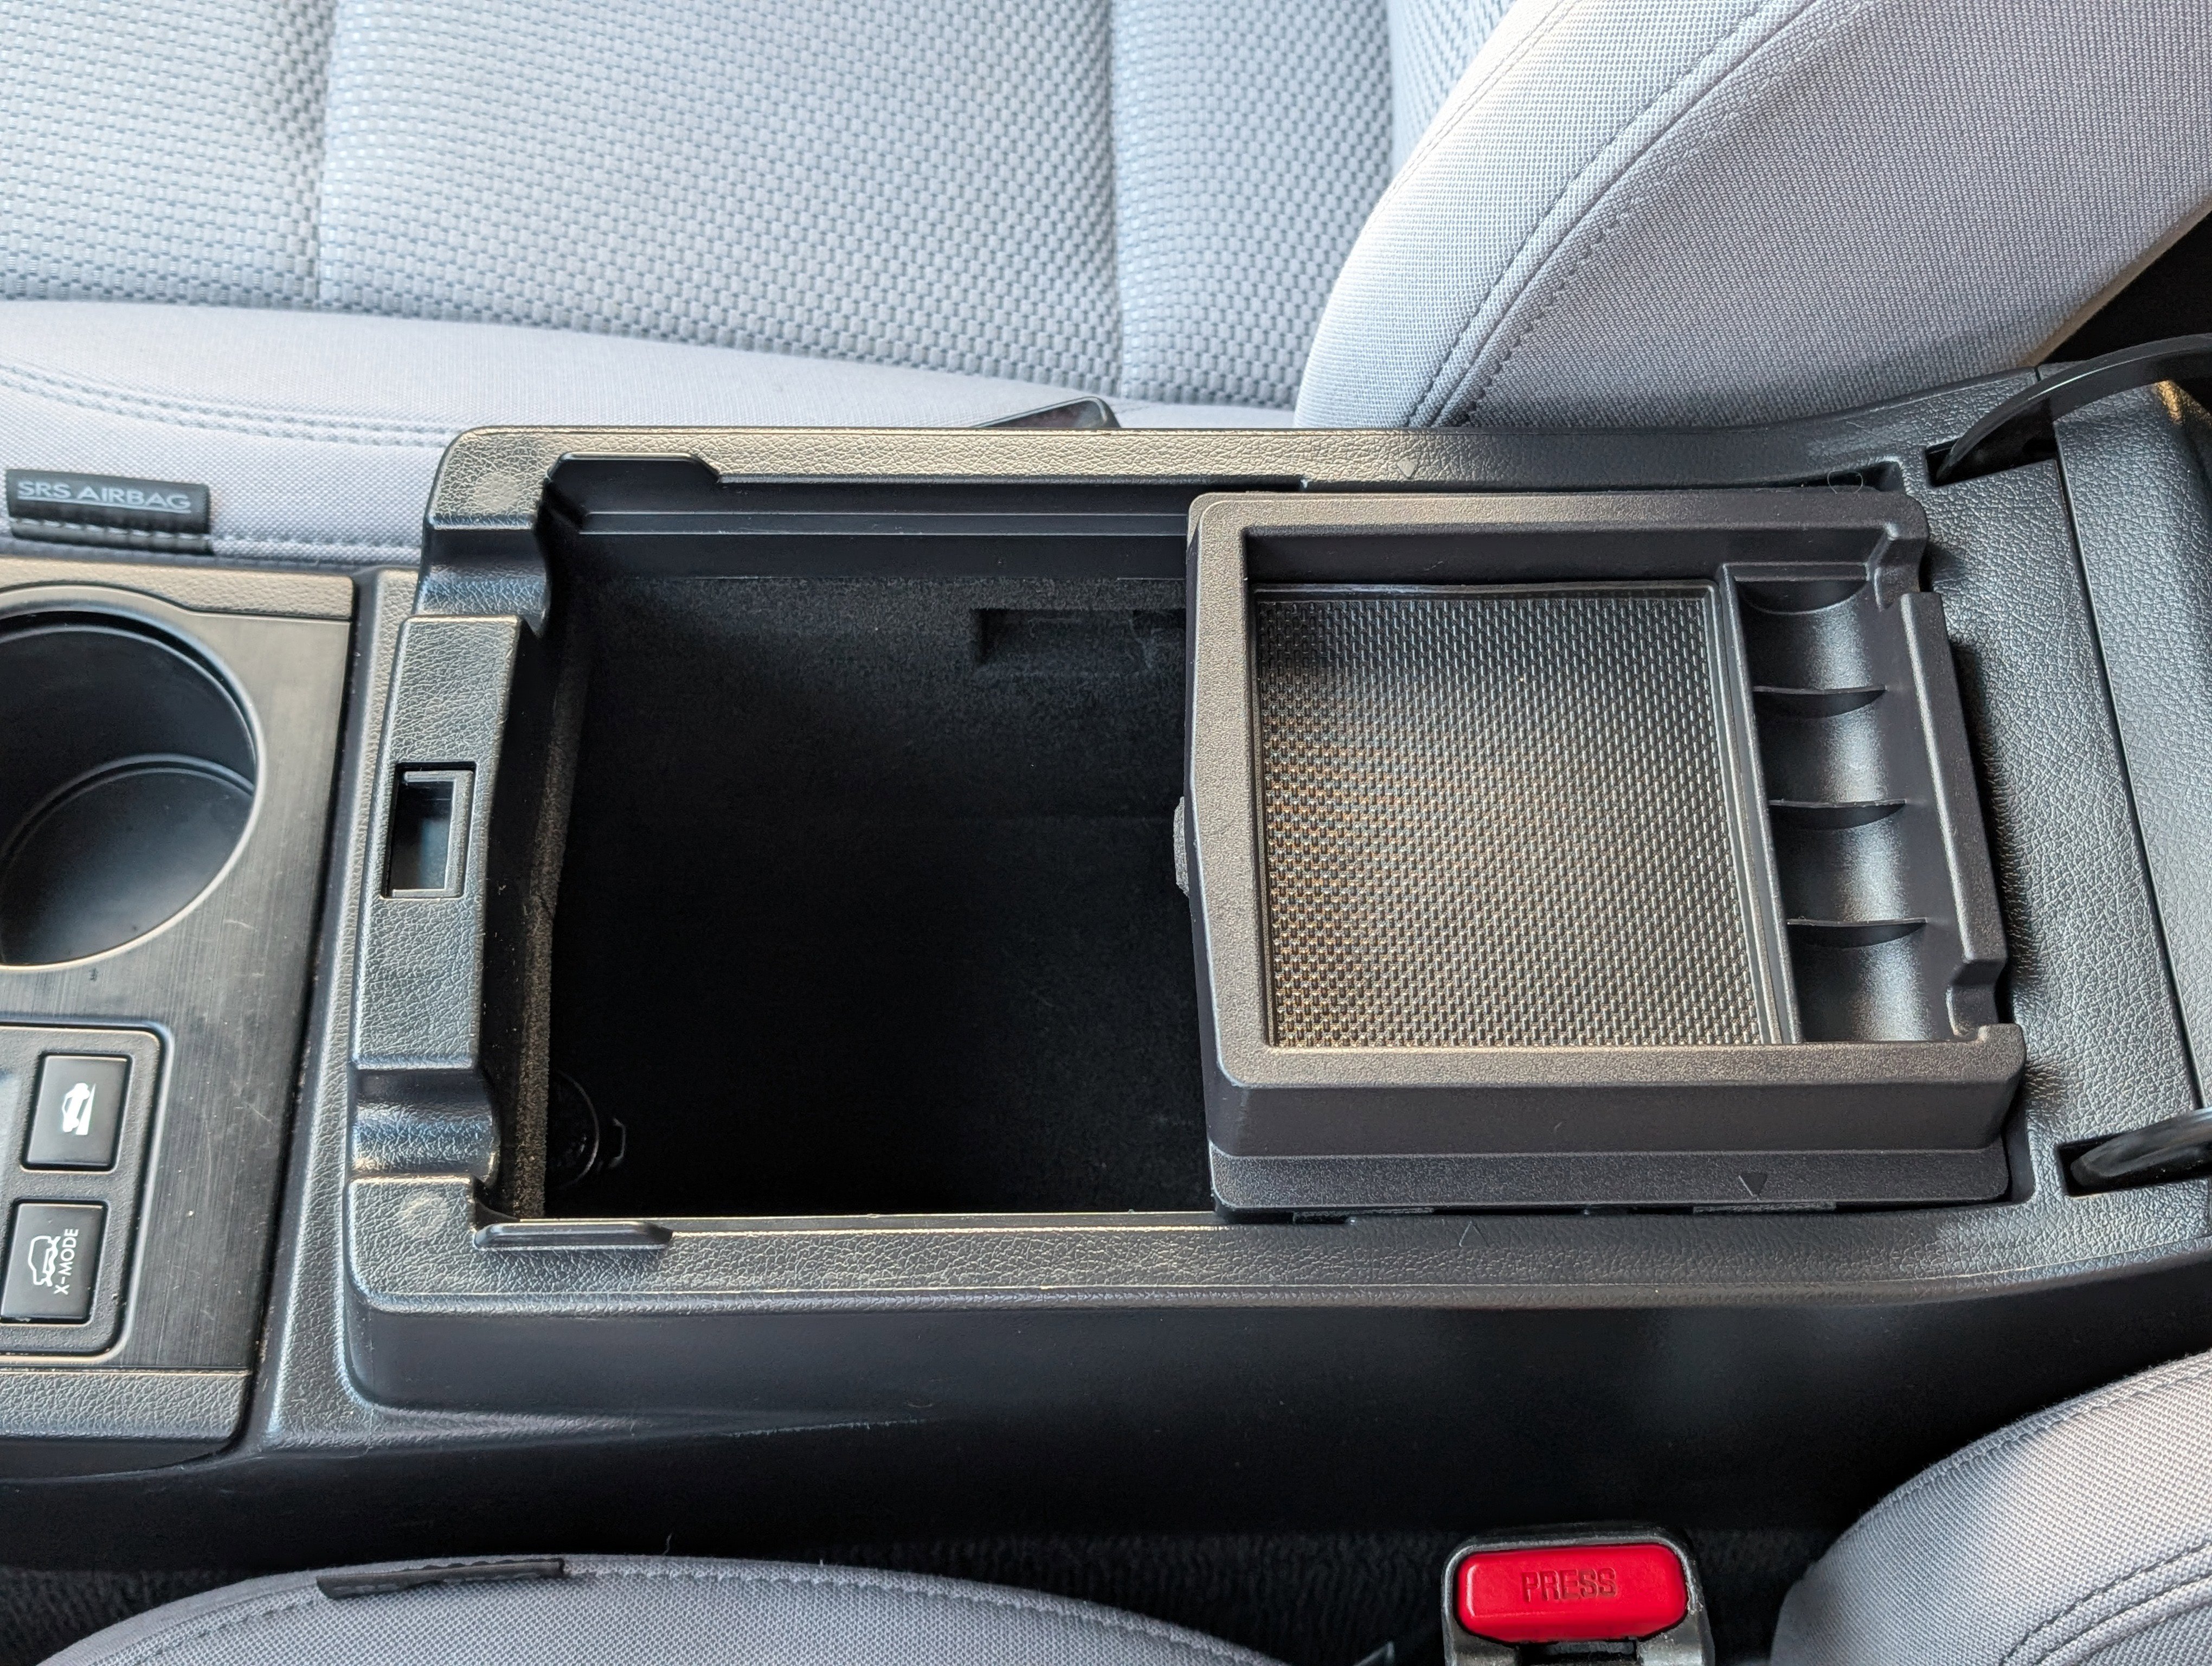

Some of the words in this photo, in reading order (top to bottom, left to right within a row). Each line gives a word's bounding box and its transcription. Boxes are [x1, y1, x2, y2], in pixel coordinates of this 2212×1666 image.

[18, 480, 72, 499] SRS
[76, 485, 191, 510] AIRBAG
[53, 1228, 79, 1295] X-MODE
[1522, 1567, 1618, 1603] PRESS
